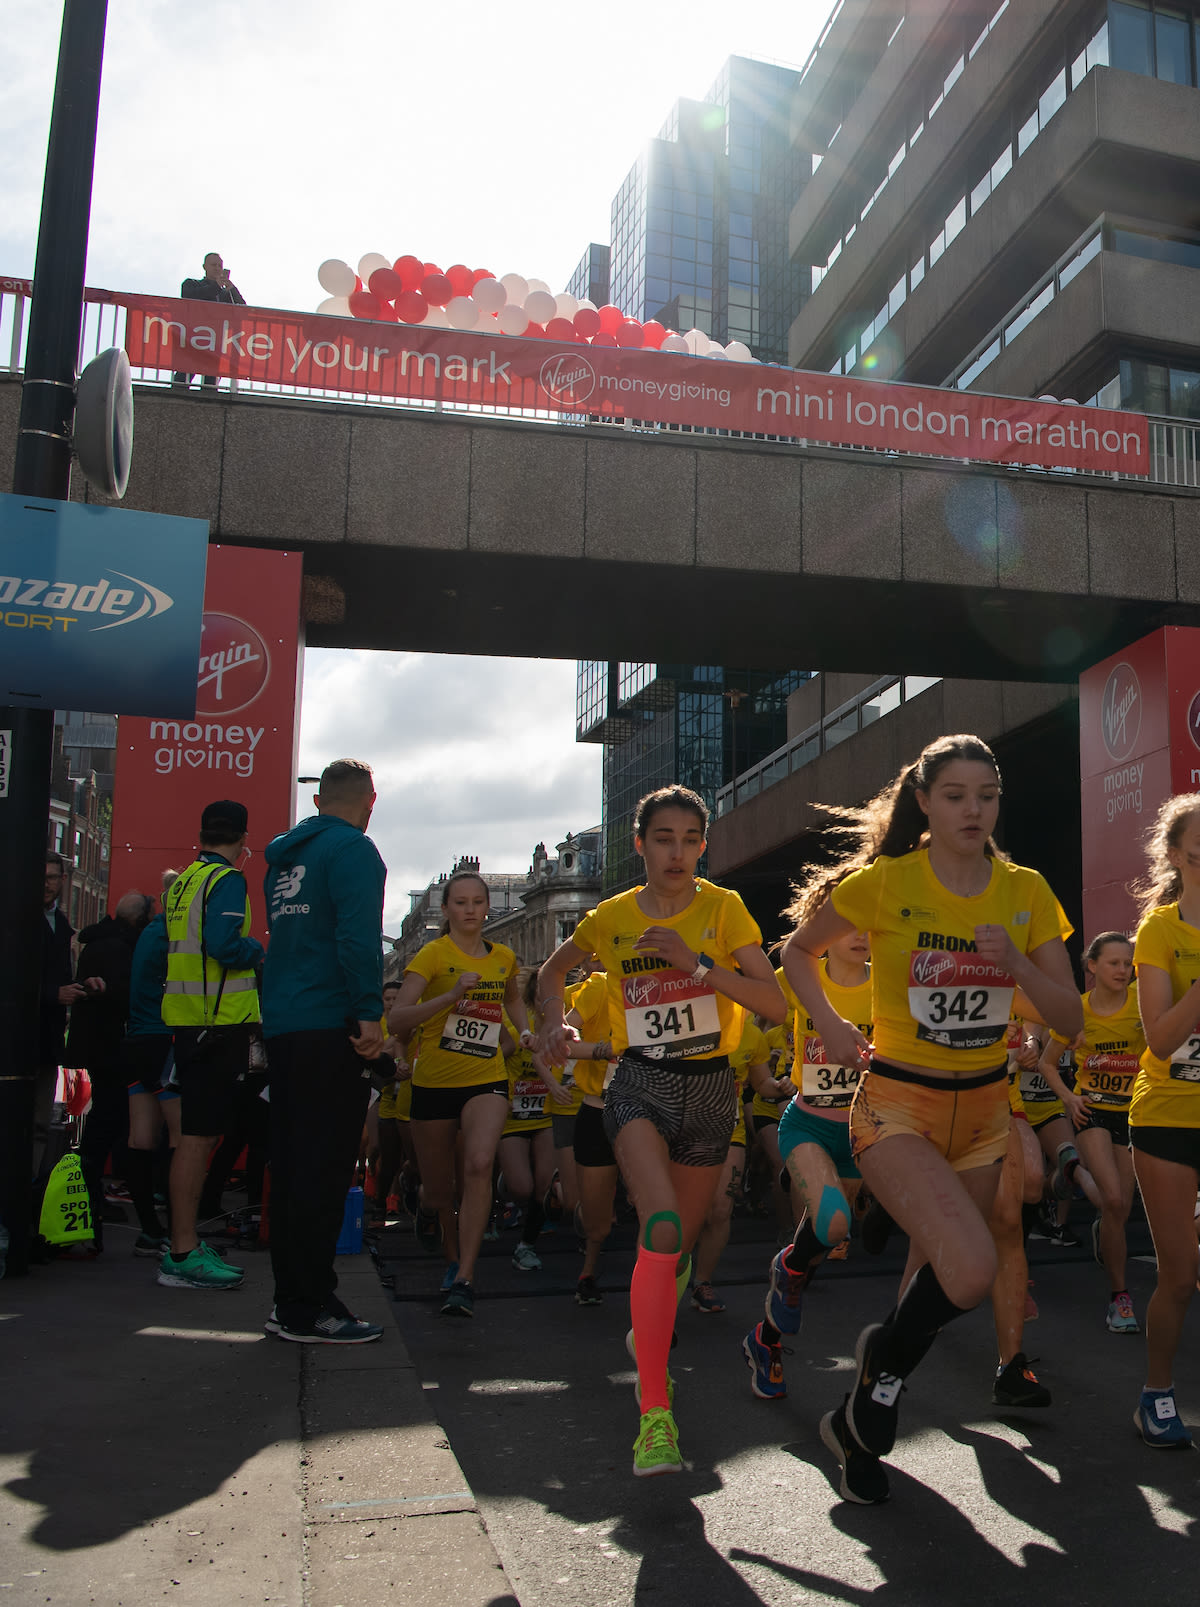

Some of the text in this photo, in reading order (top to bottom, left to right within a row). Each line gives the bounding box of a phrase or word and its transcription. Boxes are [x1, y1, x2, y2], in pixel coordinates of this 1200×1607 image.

[143, 315, 512, 385] make your mark
[545, 358, 591, 397] Virgin
[756, 385, 1142, 456] mini london marathon
[1106, 678, 1138, 747] Virgin
[149, 721, 265, 751] money
[154, 742, 255, 778] giving
[1103, 762, 1145, 793] money
[914, 951, 954, 985] Virgin
[626, 977, 658, 1004] Virgin
[644, 1003, 696, 1039] 341
[928, 990, 989, 1024] 342
[455, 1019, 489, 1041] 867
[1095, 1041, 1129, 1051] NORTH
[684, 1043, 715, 1056] balance
[1110, 1059, 1139, 1068] money
[1088, 1072, 1134, 1092] 3097
